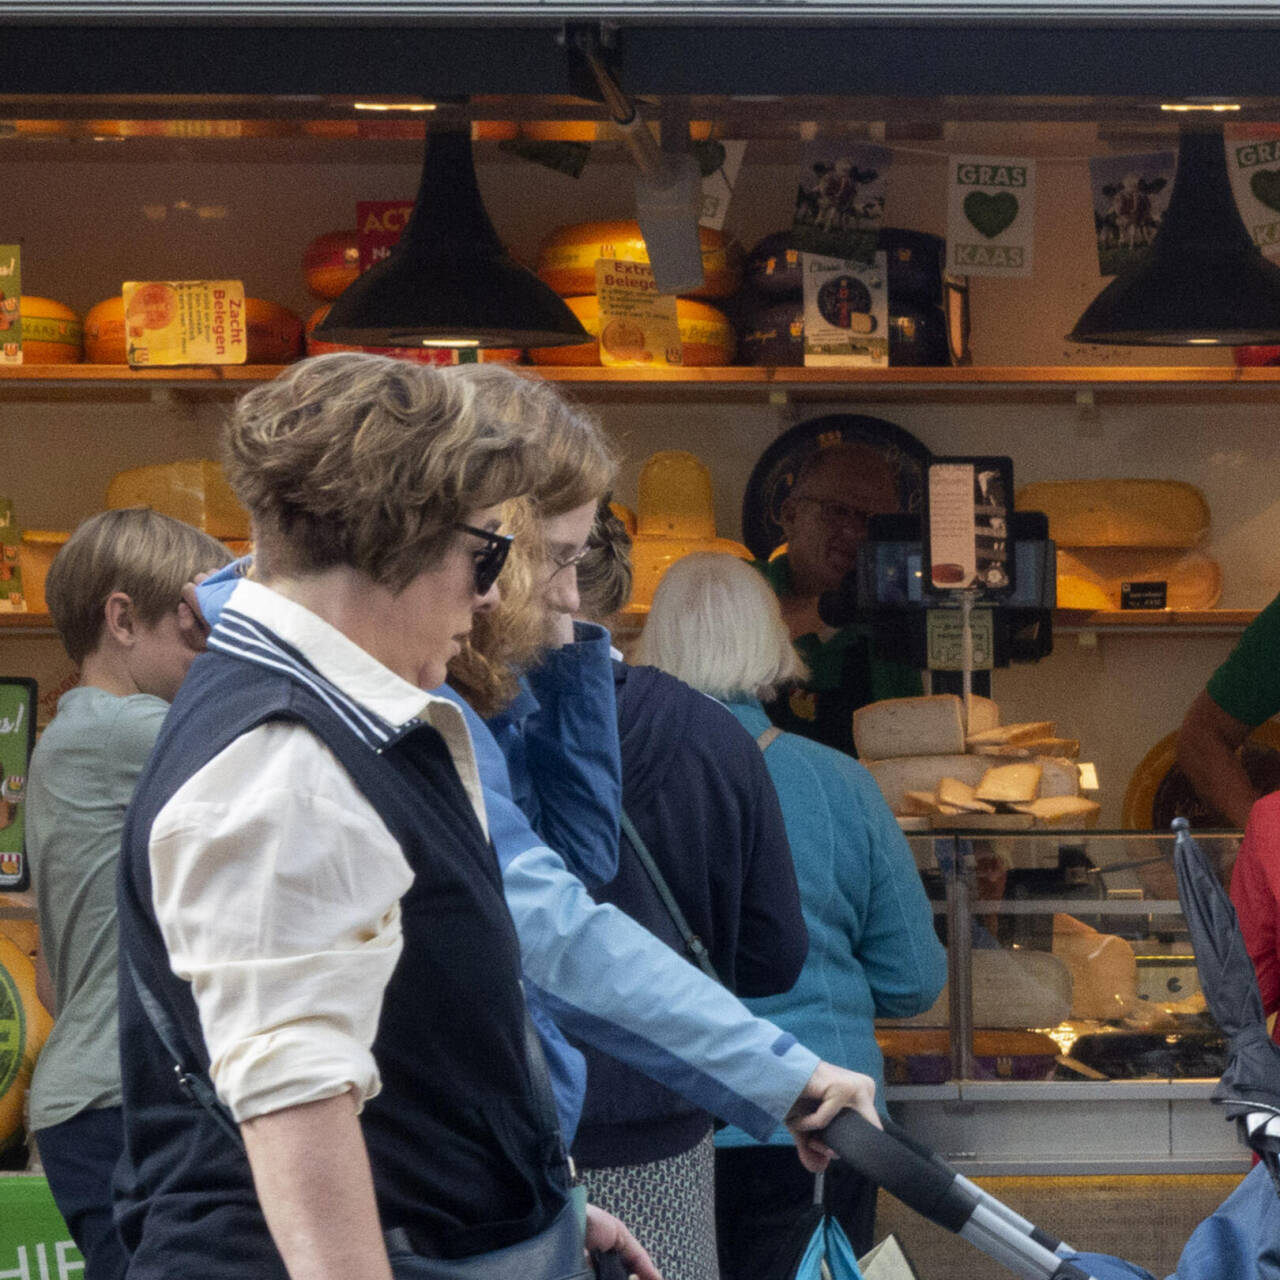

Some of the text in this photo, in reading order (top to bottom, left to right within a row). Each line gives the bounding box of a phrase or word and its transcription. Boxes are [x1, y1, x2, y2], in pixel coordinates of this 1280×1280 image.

[957, 164, 1027, 187] GRAS
[954, 244, 1024, 267] KAAS
[604, 274, 656, 290] Belege
